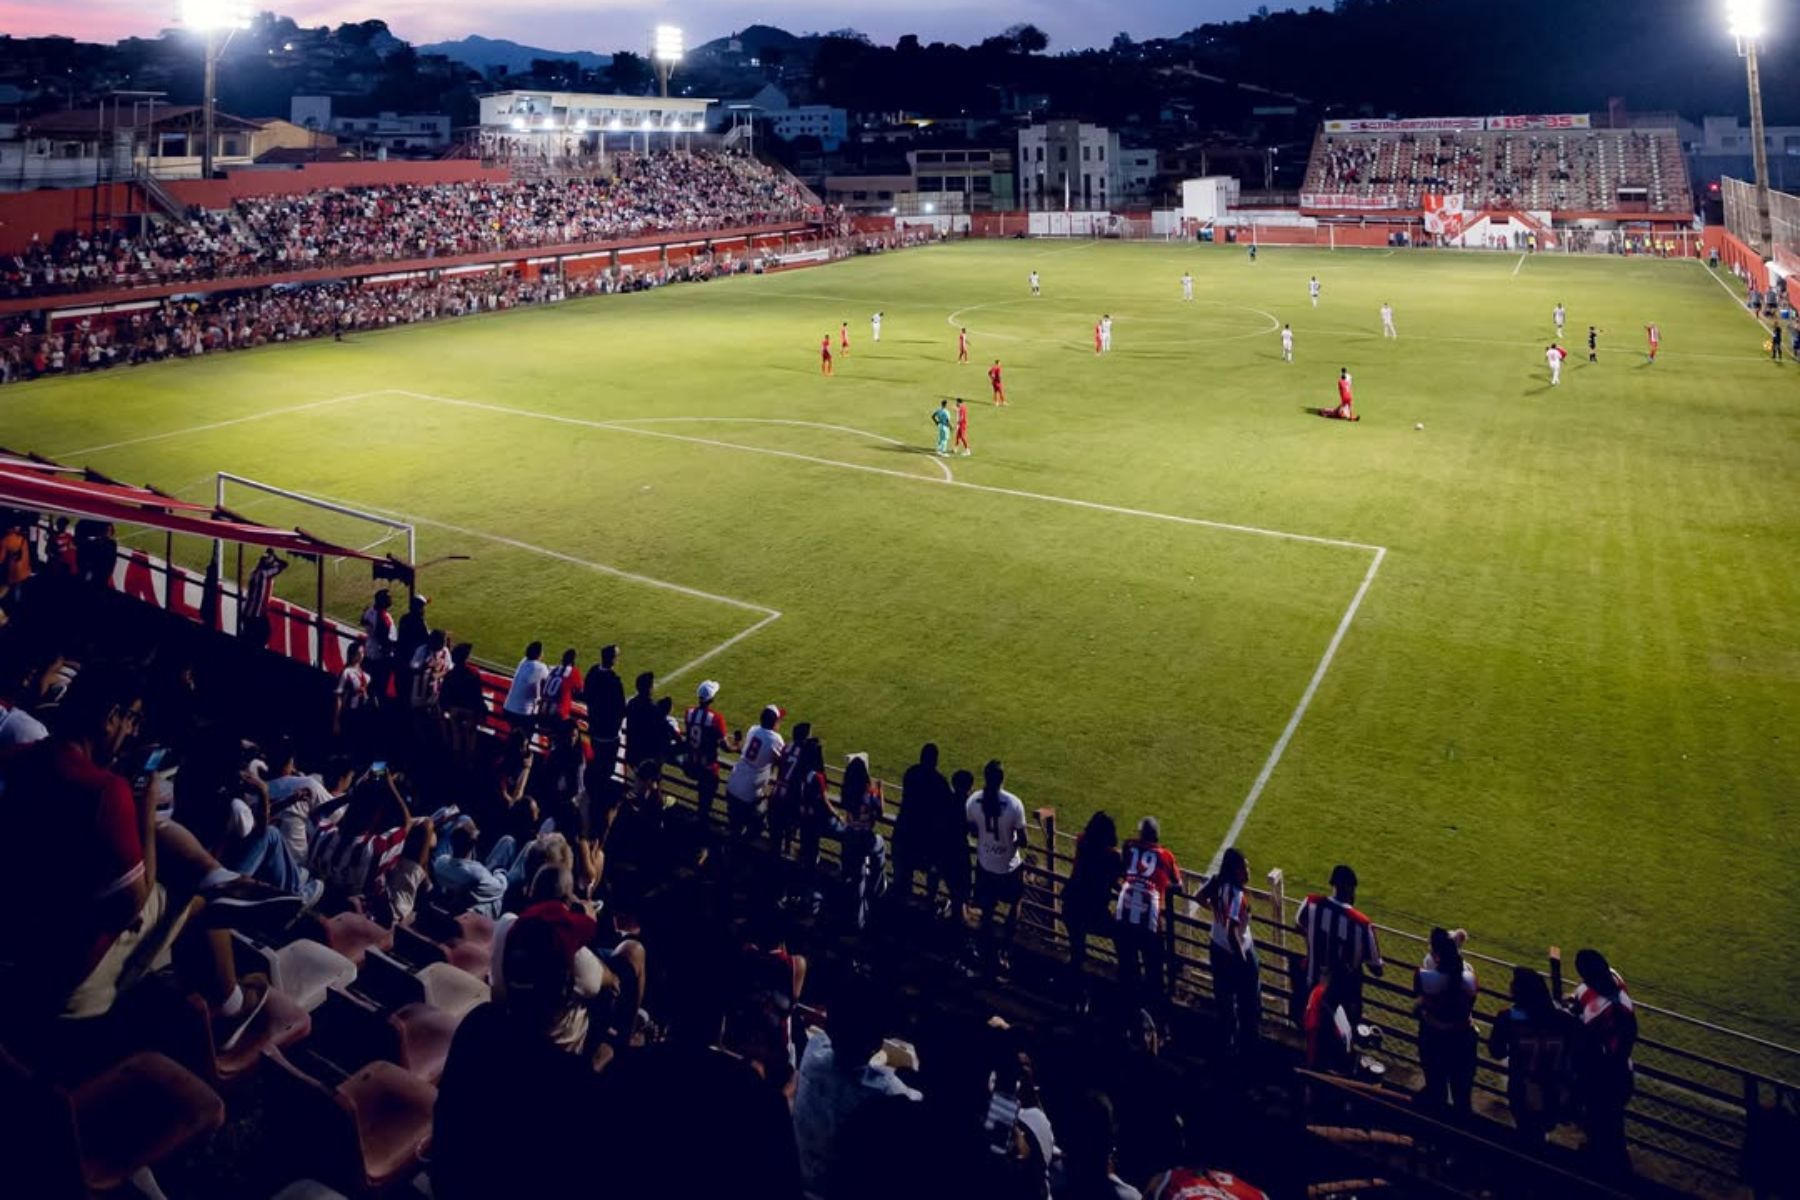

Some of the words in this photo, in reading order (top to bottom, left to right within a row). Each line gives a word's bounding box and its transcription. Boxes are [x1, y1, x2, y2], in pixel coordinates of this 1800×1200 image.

[746, 736, 762, 761] 8
[1125, 846, 1158, 877] 19
[1519, 1035, 1565, 1072] 77
